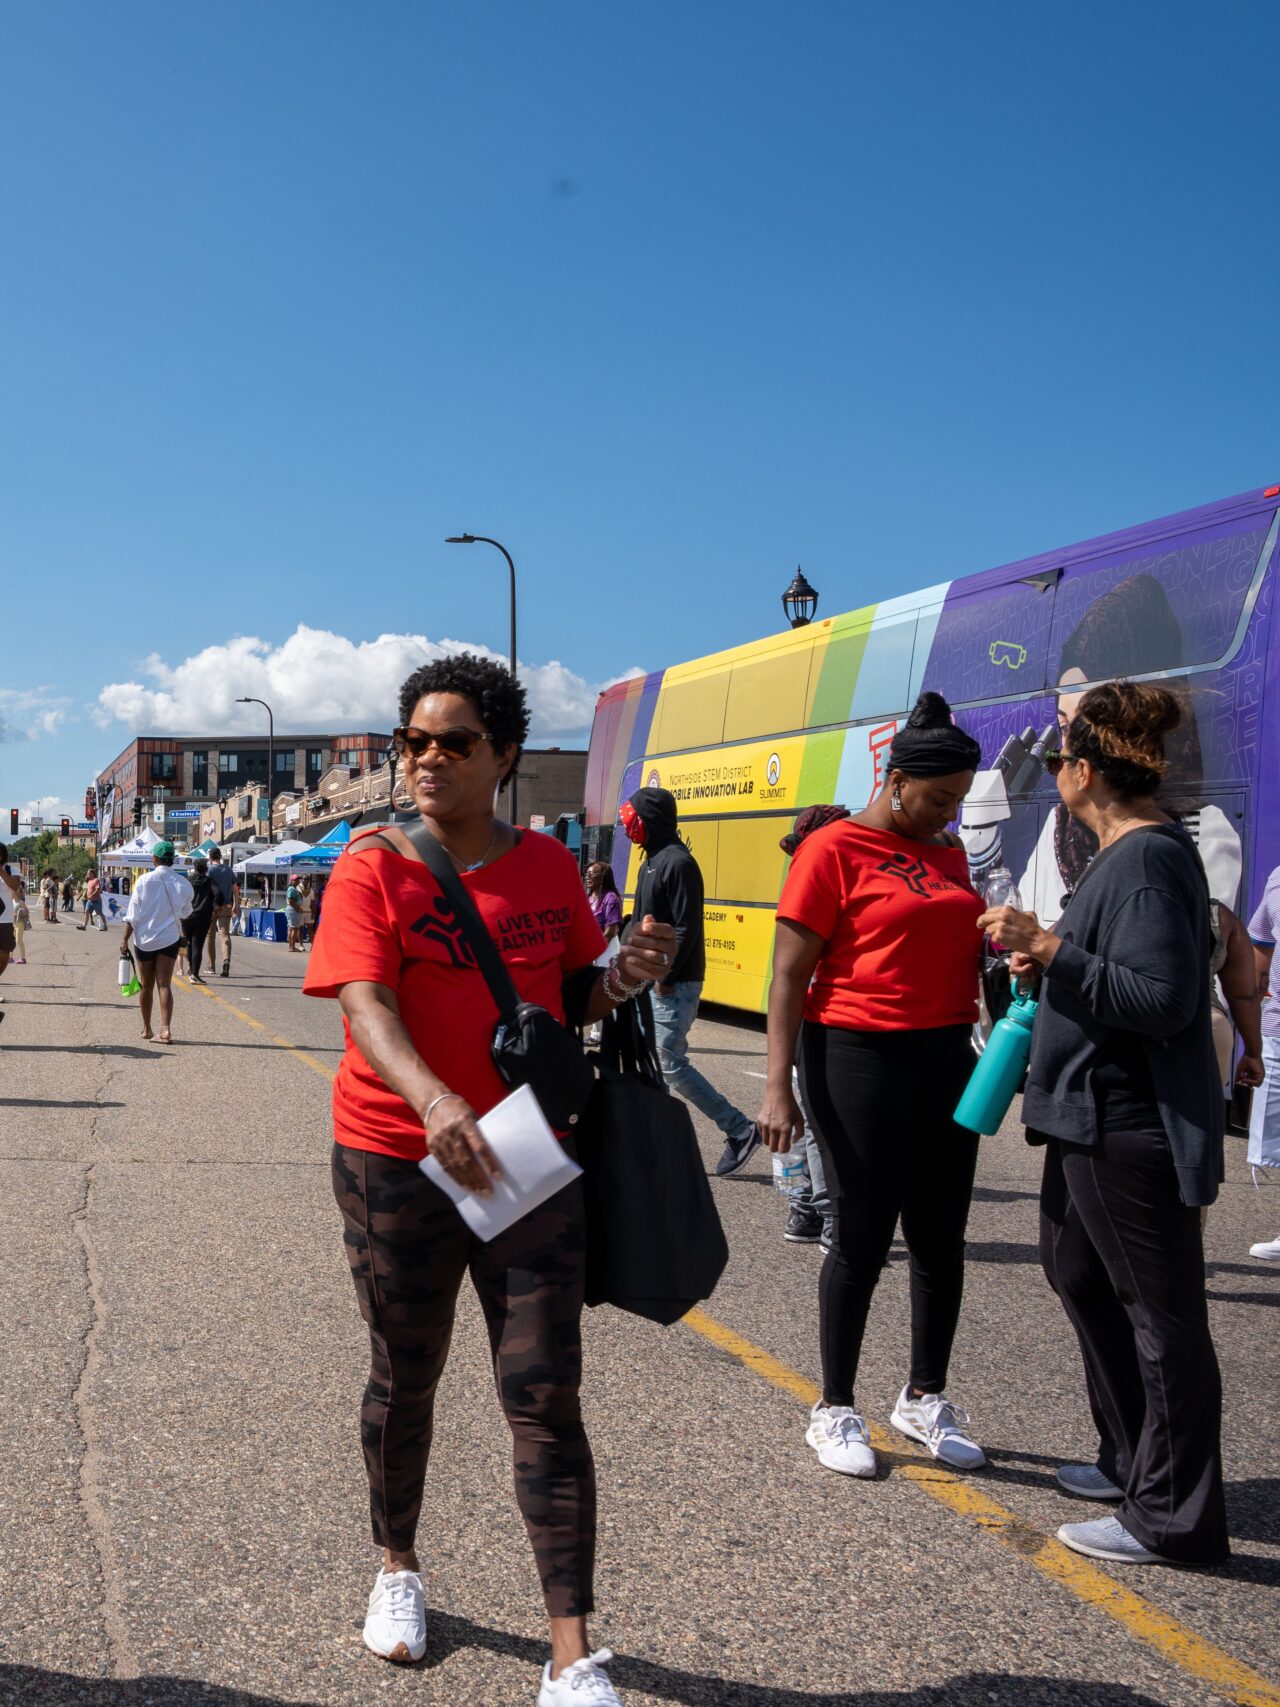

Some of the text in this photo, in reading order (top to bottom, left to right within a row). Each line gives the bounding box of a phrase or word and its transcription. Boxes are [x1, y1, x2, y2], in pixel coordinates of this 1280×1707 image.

[703, 767, 721, 782] STEM
[723, 766, 752, 780] DISTRICT
[692, 783, 737, 799] INNOVATION
[738, 780, 754, 795] LAB
[759, 787, 787, 799] SUMMIT
[927, 881, 960, 891] HEAL
[497, 907, 570, 933] LIVE YOUR
[492, 926, 570, 952] EALTHY LYF
